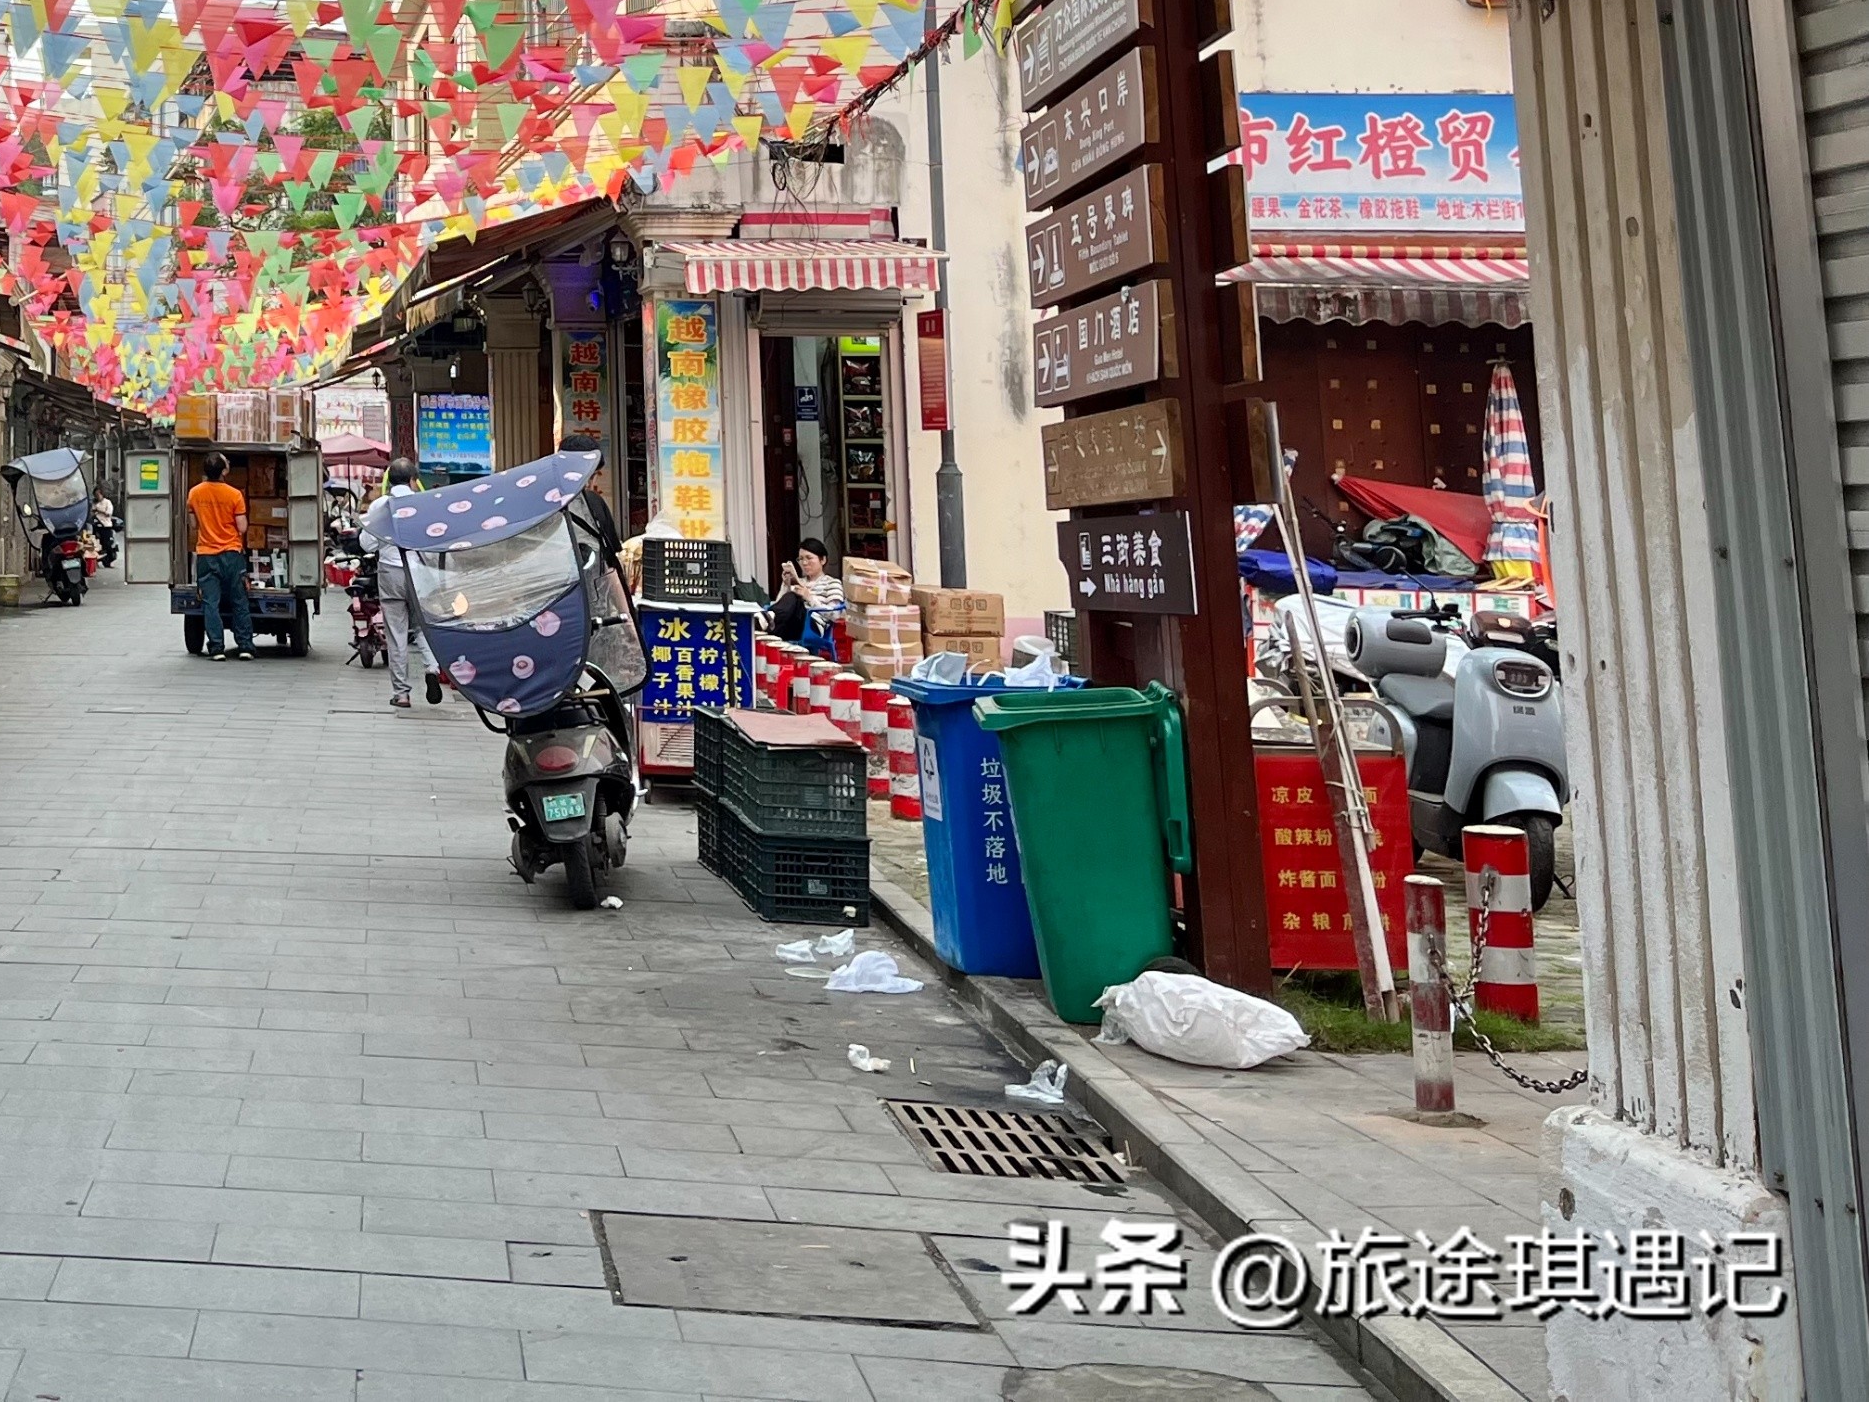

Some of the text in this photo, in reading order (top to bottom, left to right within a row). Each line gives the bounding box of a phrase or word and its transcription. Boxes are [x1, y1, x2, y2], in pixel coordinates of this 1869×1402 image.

[1228, 108, 1521, 184] 市红橙贸
[651, 644, 673, 716] 椰子汁
[674, 646, 696, 717] 百香果汁
[980, 756, 1009, 885] 垃圾不落地
[1271, 786, 1315, 804] 凉皮
[1274, 828, 1333, 846] 酸辣粉
[1278, 869, 1337, 888] 炸酱面
